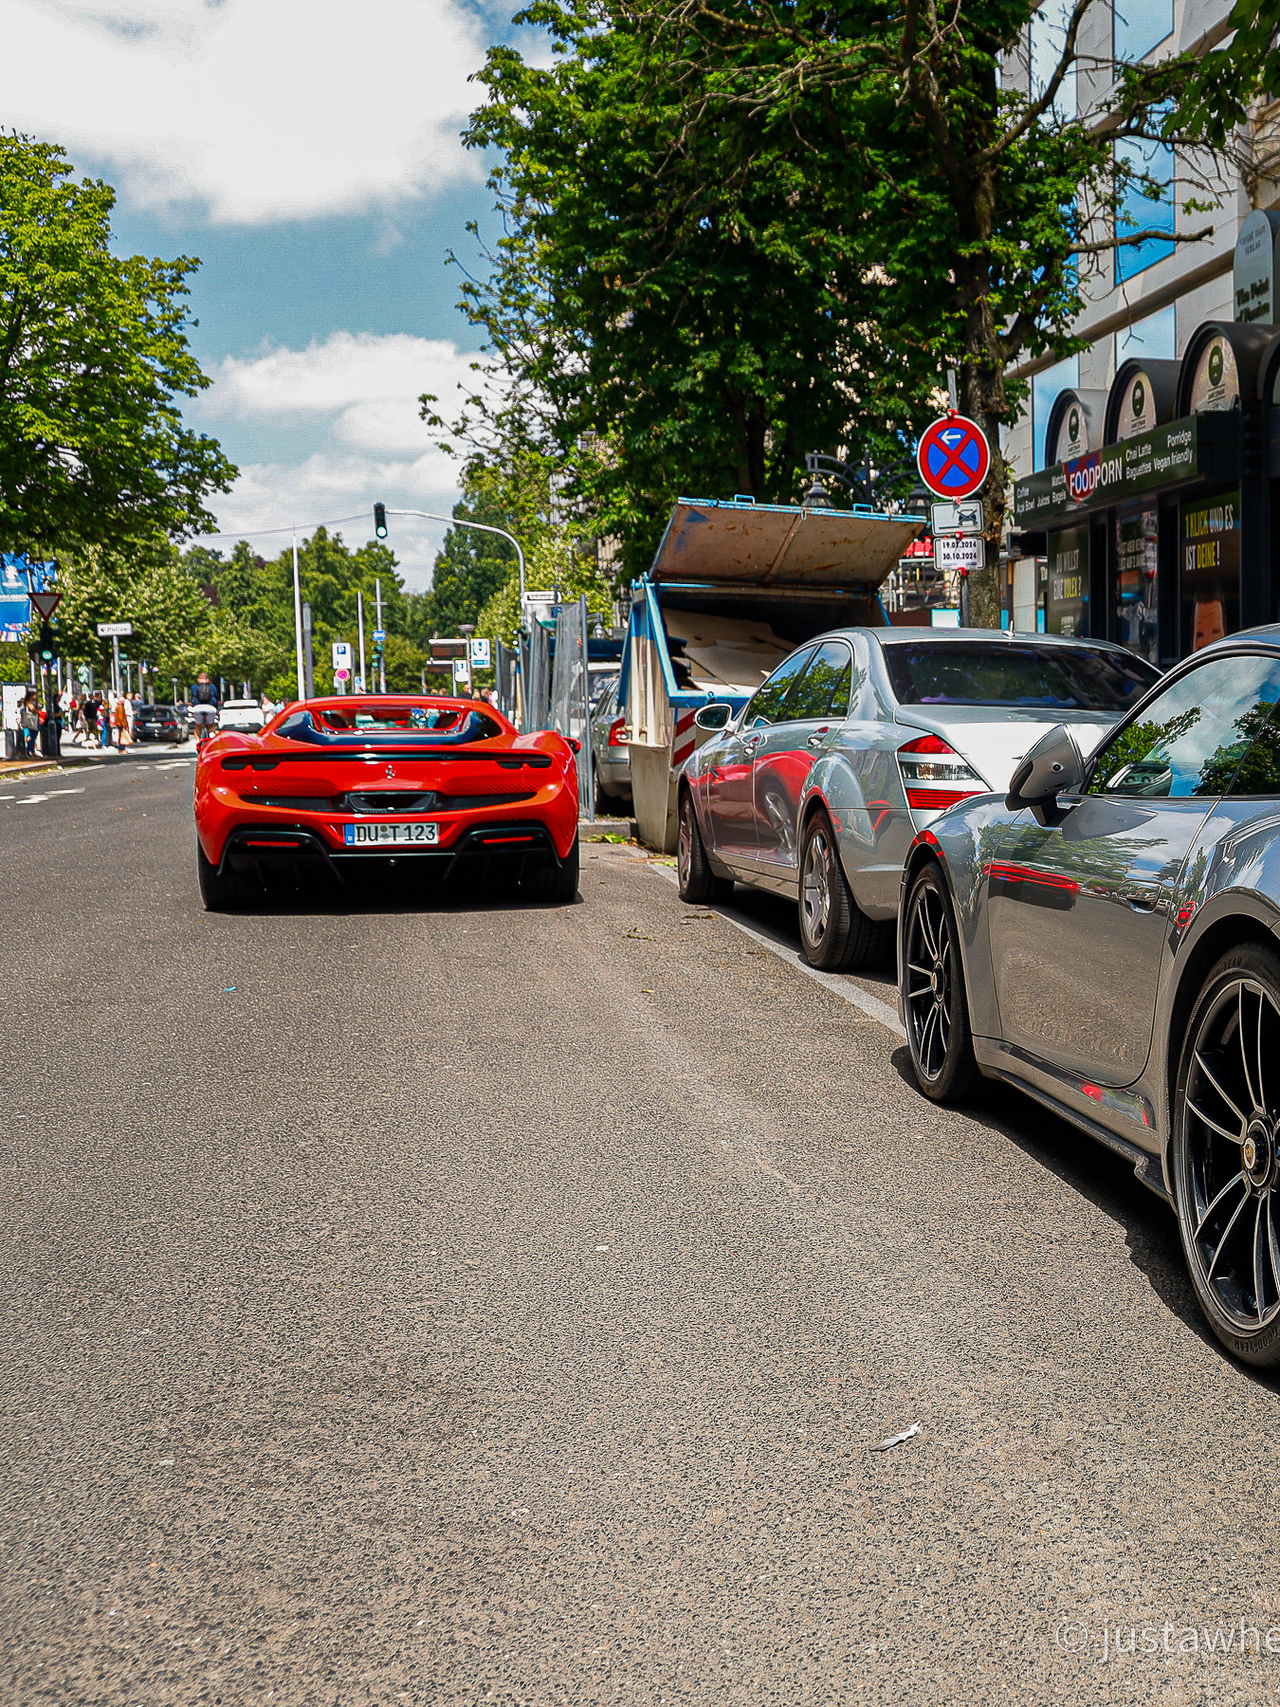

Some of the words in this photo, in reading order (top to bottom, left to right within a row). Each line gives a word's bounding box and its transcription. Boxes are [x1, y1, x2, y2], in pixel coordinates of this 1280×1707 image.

[1168, 430, 1192, 448] Porridge
[1126, 448, 1138, 462] Chai
[1138, 444, 1152, 458] Latte
[1154, 455, 1171, 472] Vegan
[1171, 447, 1193, 464] friendly
[1070, 456, 1122, 496] FOODPORN
[1126, 462, 1152, 480] Baguettes
[1190, 509, 1208, 537] KLICK
[1210, 506, 1223, 533] UND
[1225, 504, 1234, 530] ES
[1186, 544, 1196, 571] IST
[1197, 541, 1216, 569] DEINE
[356, 825, 378, 842] DU
[389, 825, 400, 841] T
[403, 825, 435, 841] 123
